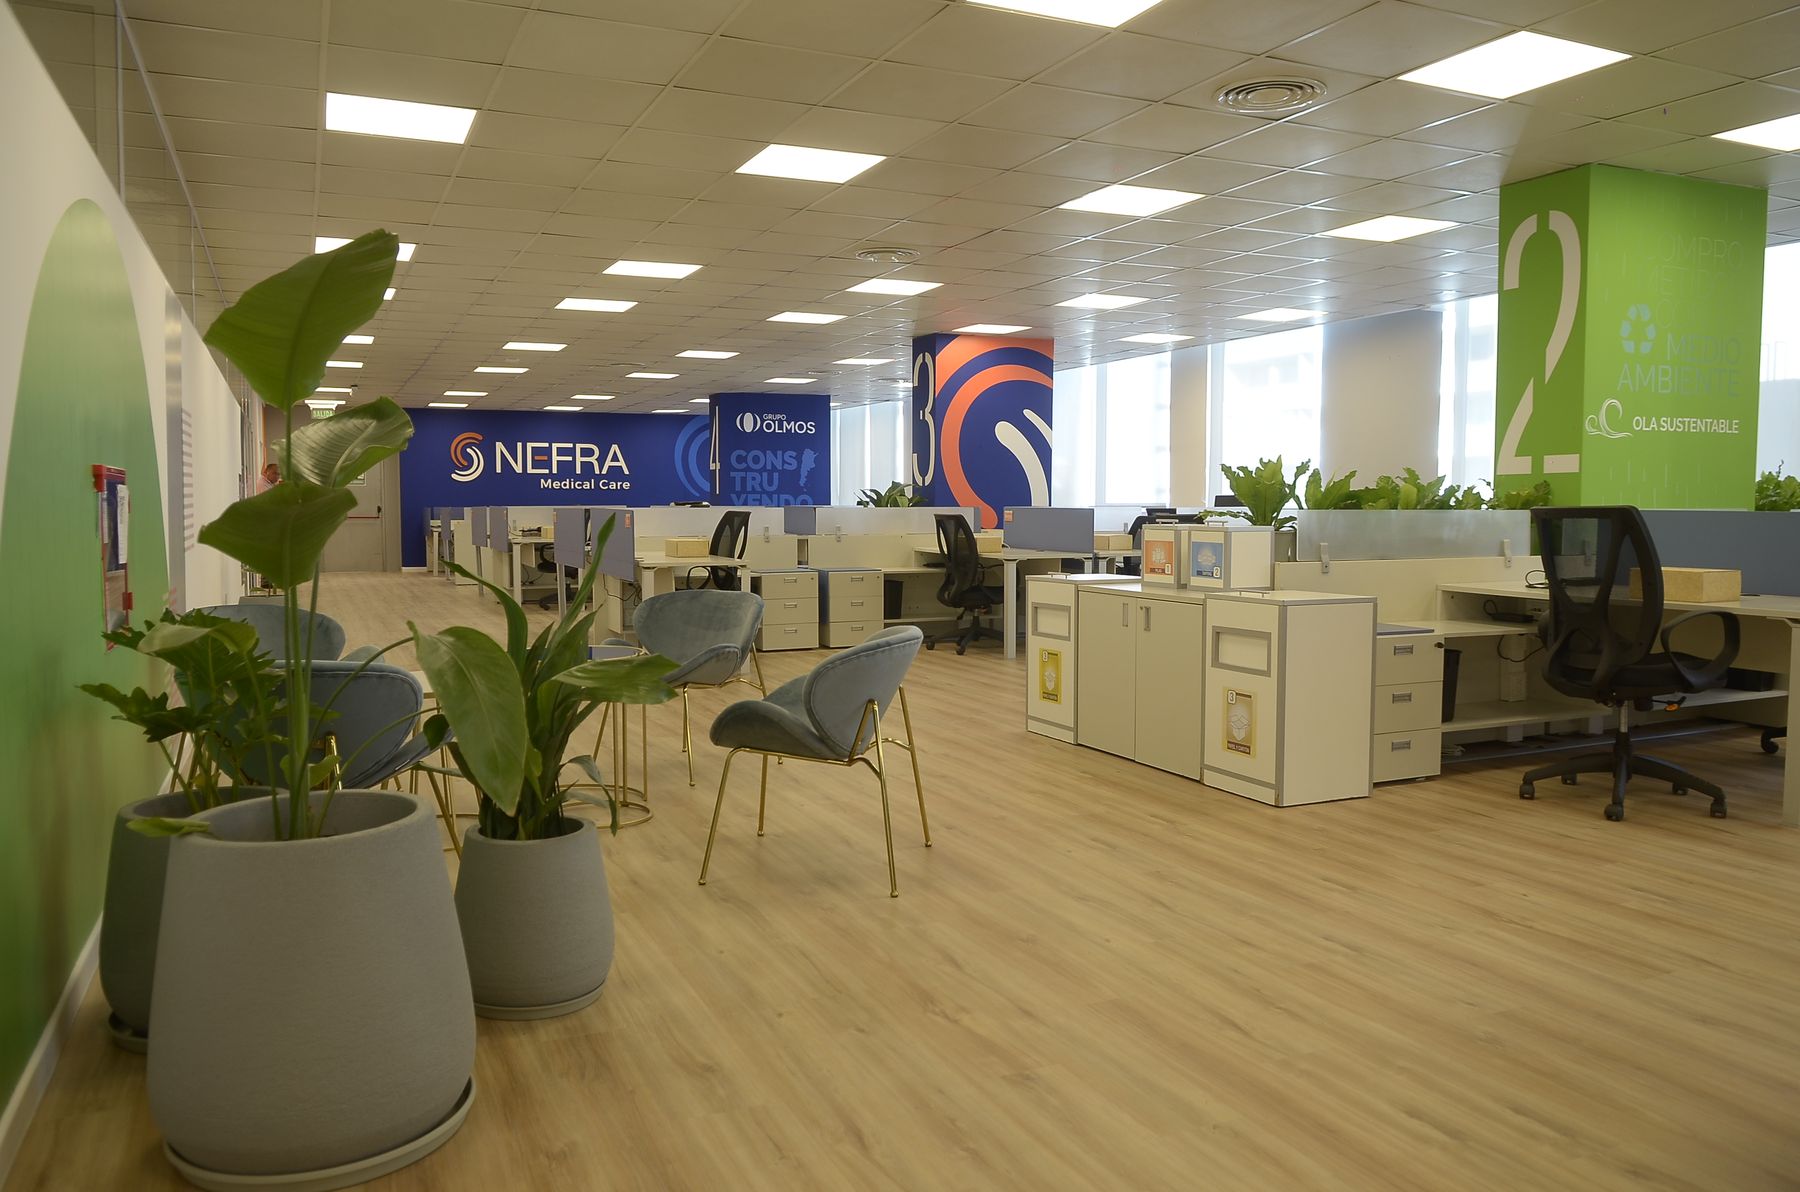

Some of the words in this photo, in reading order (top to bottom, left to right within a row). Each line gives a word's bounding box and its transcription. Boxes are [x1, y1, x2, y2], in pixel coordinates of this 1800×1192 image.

[1646, 232, 1744, 272] OMPRO
[1496, 210, 1582, 475] 2
[1617, 363, 1742, 398] AMBIENTE
[762, 413, 786, 421] GRUPO
[762, 420, 816, 434] OLMOS
[912, 352, 936, 487] 3
[1632, 416, 1658, 430] OLA
[1660, 417, 1740, 433] SUSTENTABLE
[495, 441, 630, 475] NEFRA
[730, 449, 798, 471] CONS
[540, 478, 595, 490] Medical
[599, 479, 631, 490] Care
[730, 471, 779, 492] TRU
